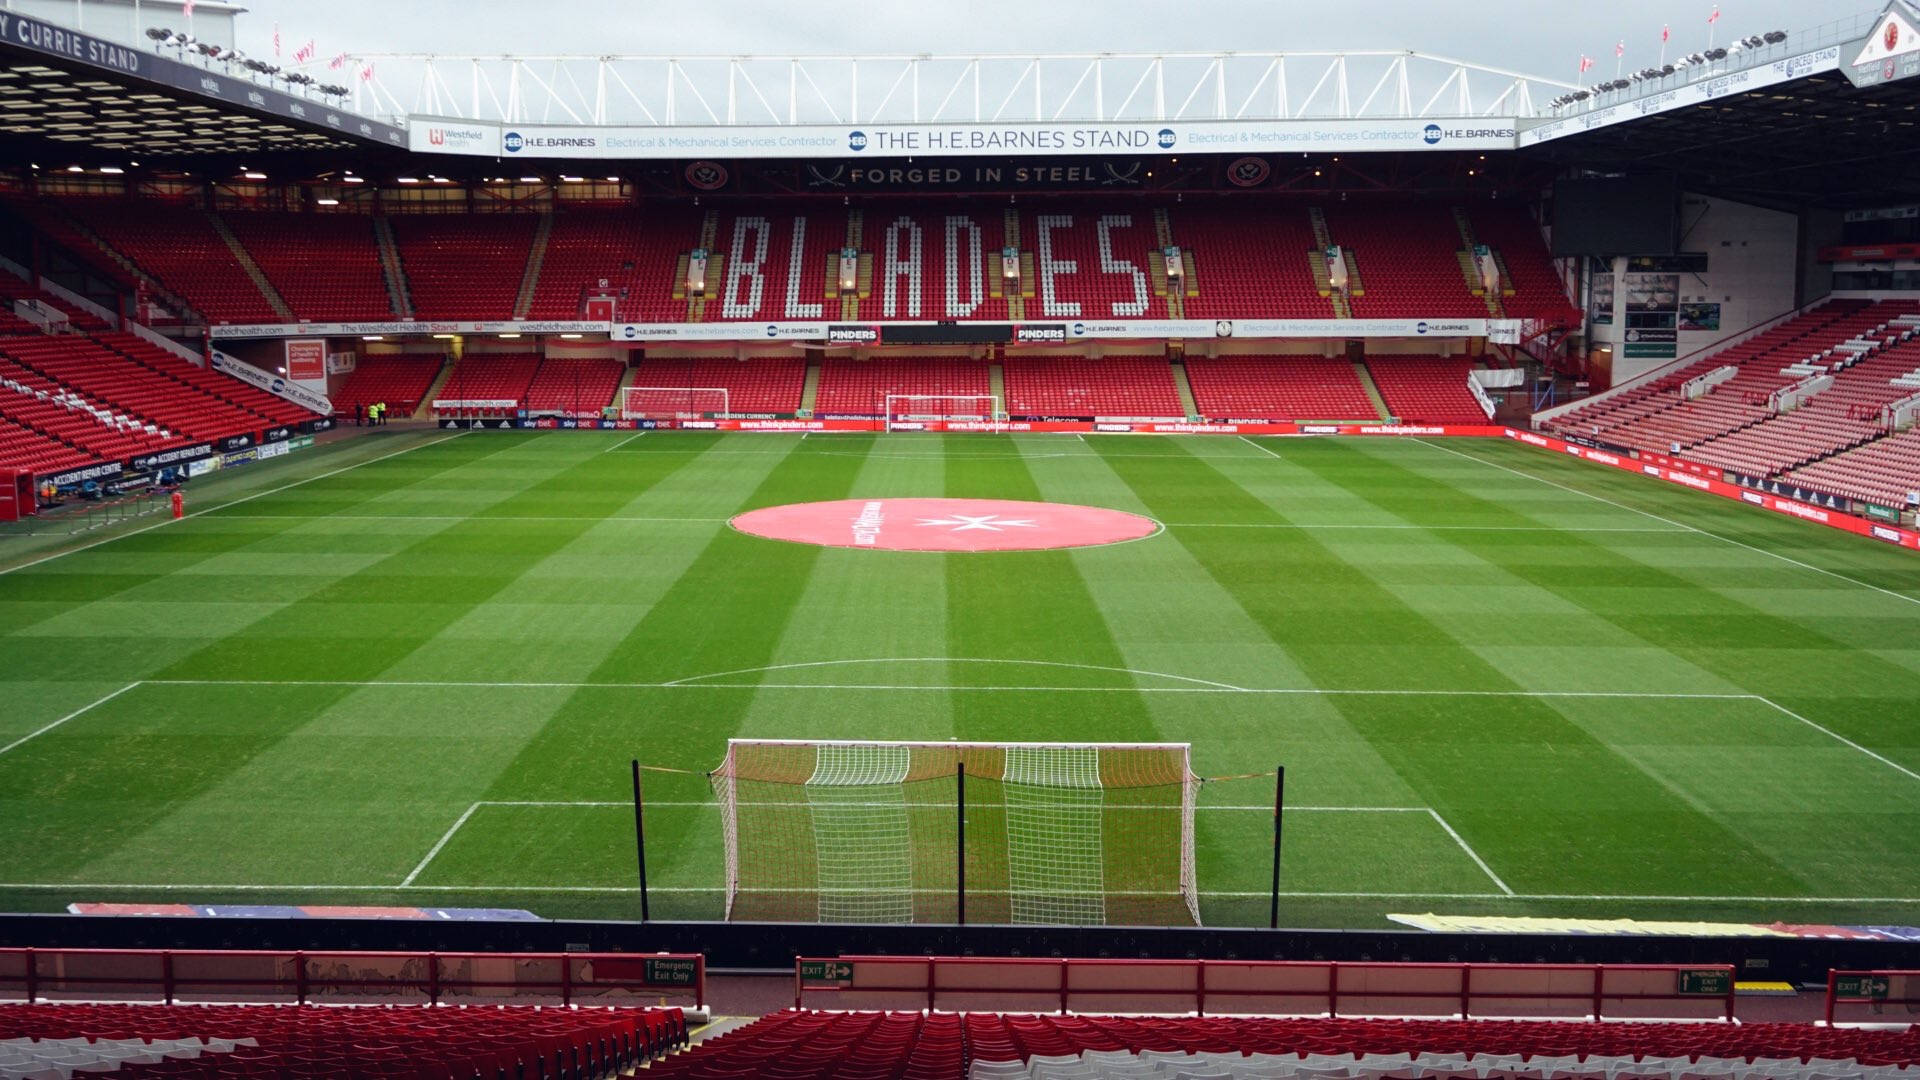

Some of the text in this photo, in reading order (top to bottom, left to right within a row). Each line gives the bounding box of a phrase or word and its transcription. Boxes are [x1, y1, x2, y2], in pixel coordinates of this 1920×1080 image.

[17, 20, 82, 58] CURRIE
[89, 41, 138, 72] STAND
[1815, 47, 1837, 63] STAND
[444, 129, 482, 140] Westfield
[1188, 132, 1238, 144] Electrical
[1240, 133, 1249, 143] &
[1252, 131, 1311, 142] Mechanical
[1313, 130, 1359, 142] Services
[1362, 129, 1419, 141] Contractor
[1444, 128, 1514, 139] H.E.BARNES
[525, 138, 596, 147] H.E.BARNES
[606, 136, 838, 148] Electrical & Mechanical Services Contractor
[875, 131, 920, 149] THE
[928, 131, 1065, 149] H.E.BARNES
[1073, 130, 1149, 149] STAND
[851, 166, 1096, 183] FORGED IN STEEL
[722, 214, 1150, 318] BLADES
[341, 322, 458, 333] The Westfield Health Stand
[519, 321, 604, 331] westfieldhealth.com
[830, 330, 877, 339] PINDERS
[1018, 329, 1065, 339] PINDERS
[524, 420, 536, 429] sky
[563, 420, 591, 429] sky bet
[603, 420, 631, 429] sky bet
[643, 420, 671, 429] sky bet
[740, 420, 824, 431] www.thinkpinders.com
[54, 471, 81, 485] ACCIDENT
[81, 466, 101, 479] REPAIR
[101, 462, 122, 475] CENTRE
[654, 960, 694, 971] Emergency
[802, 966, 822, 975] EXIT
[655, 971, 689, 982] Exit Only
[1837, 982, 1858, 991] EXIT
